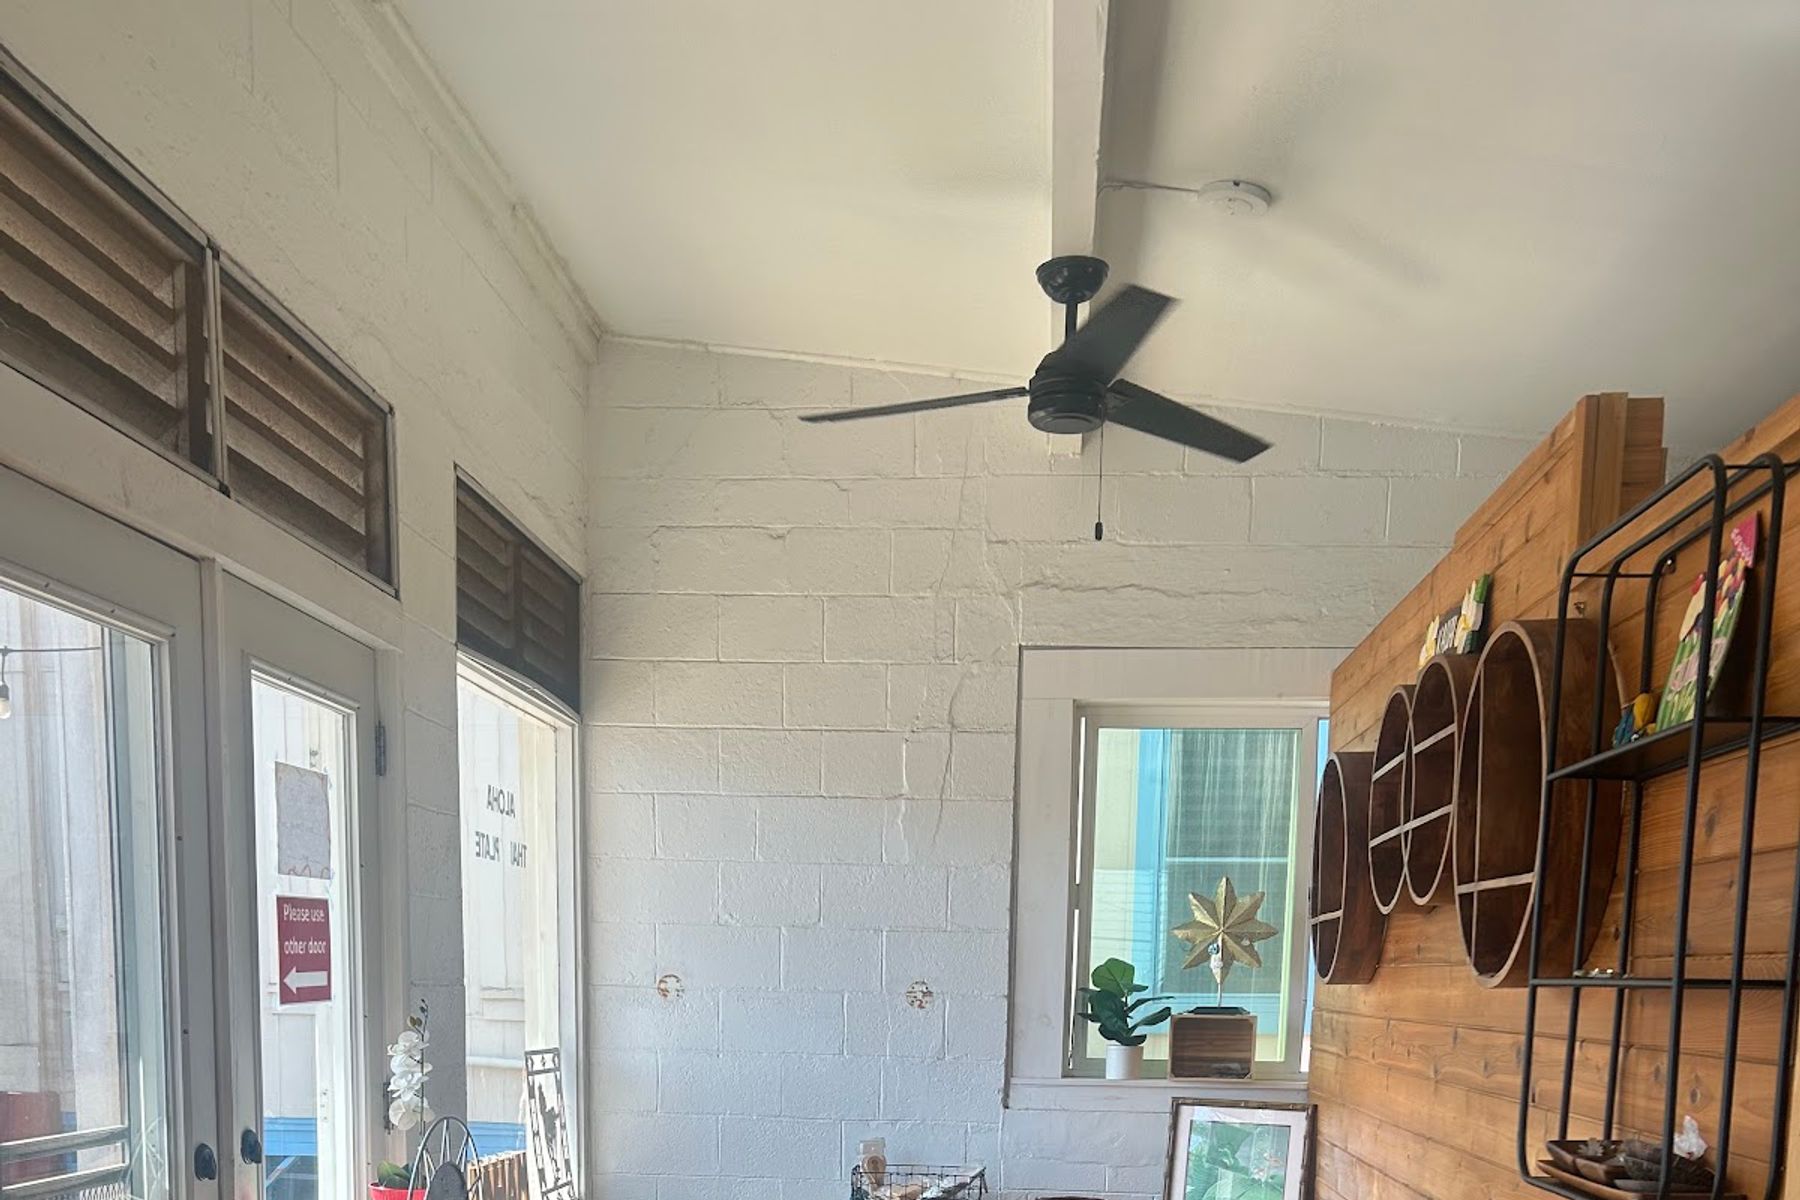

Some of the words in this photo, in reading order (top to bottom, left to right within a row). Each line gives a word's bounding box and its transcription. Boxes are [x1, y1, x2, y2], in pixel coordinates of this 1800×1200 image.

[283, 903, 310, 922] Please
[311, 908, 325, 922] use
[283, 936, 307, 955] other
[308, 936, 327, 954] door
